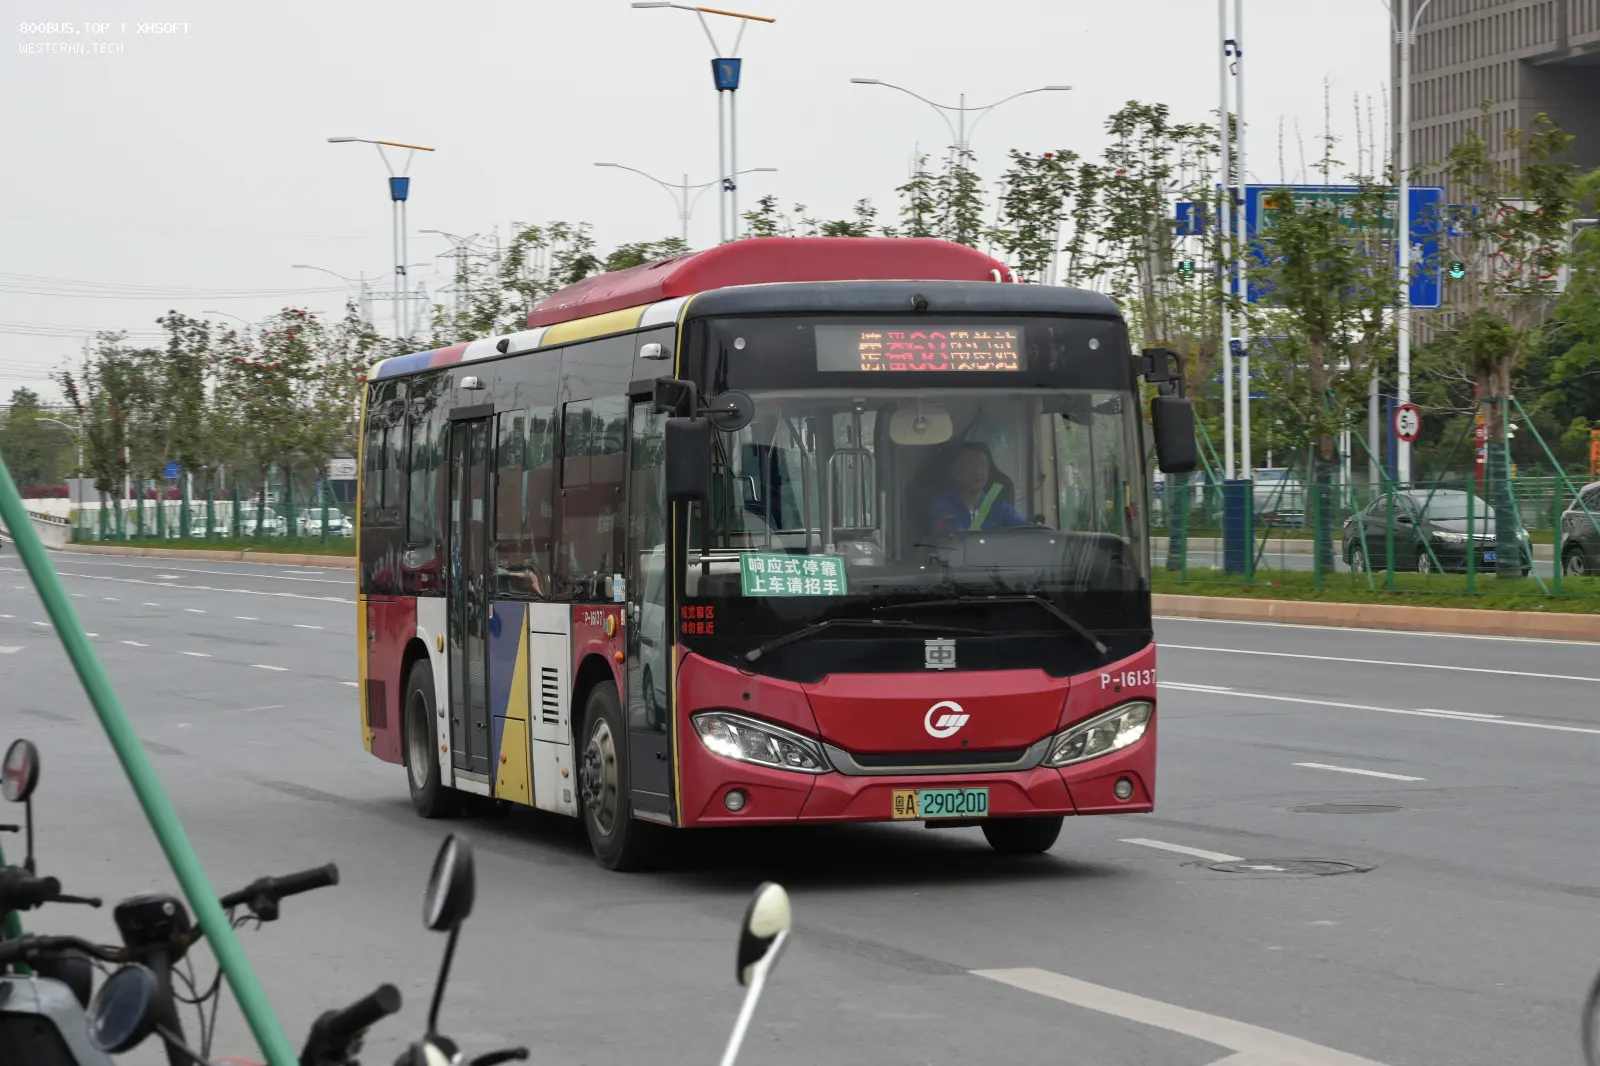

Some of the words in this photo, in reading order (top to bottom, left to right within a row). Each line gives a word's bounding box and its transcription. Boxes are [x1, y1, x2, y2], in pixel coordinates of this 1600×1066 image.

[748, 557, 838, 576] 响应式停靠
[750, 575, 839, 596] 上车请招手
[584, 610, 603, 626] P-16137
[681, 606, 715, 619] 视觉盲区
[681, 622, 715, 635] 请勿靠近
[1101, 668, 1156, 690] P-16137
